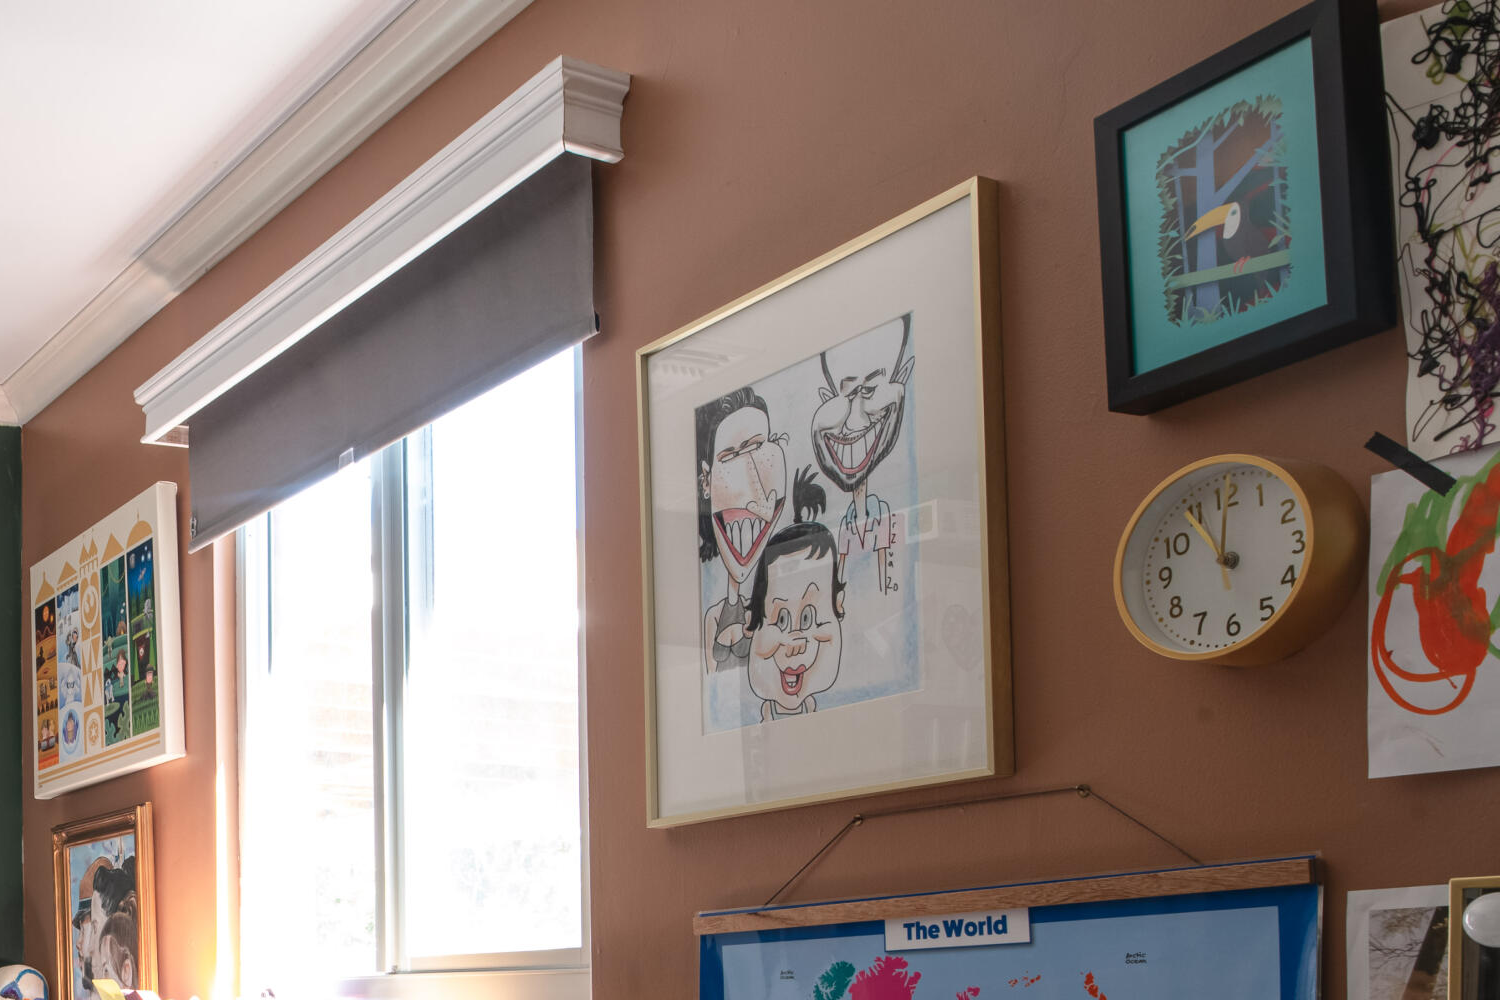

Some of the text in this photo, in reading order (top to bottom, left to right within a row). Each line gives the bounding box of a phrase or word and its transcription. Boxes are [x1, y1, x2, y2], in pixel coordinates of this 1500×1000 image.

[1214, 483, 1240, 511] 12
[1256, 483, 1264, 507] 1
[1280, 498, 1296, 524] 2
[1164, 532, 1190, 560] 10
[1291, 530, 1306, 554] 3
[1158, 566, 1172, 590] 9
[1280, 564, 1296, 588] 4
[1169, 596, 1184, 618] 8
[1260, 596, 1275, 622] 5
[1193, 611, 1208, 636] 7
[1226, 613, 1241, 636] 6
[903, 914, 1008, 941] The World
